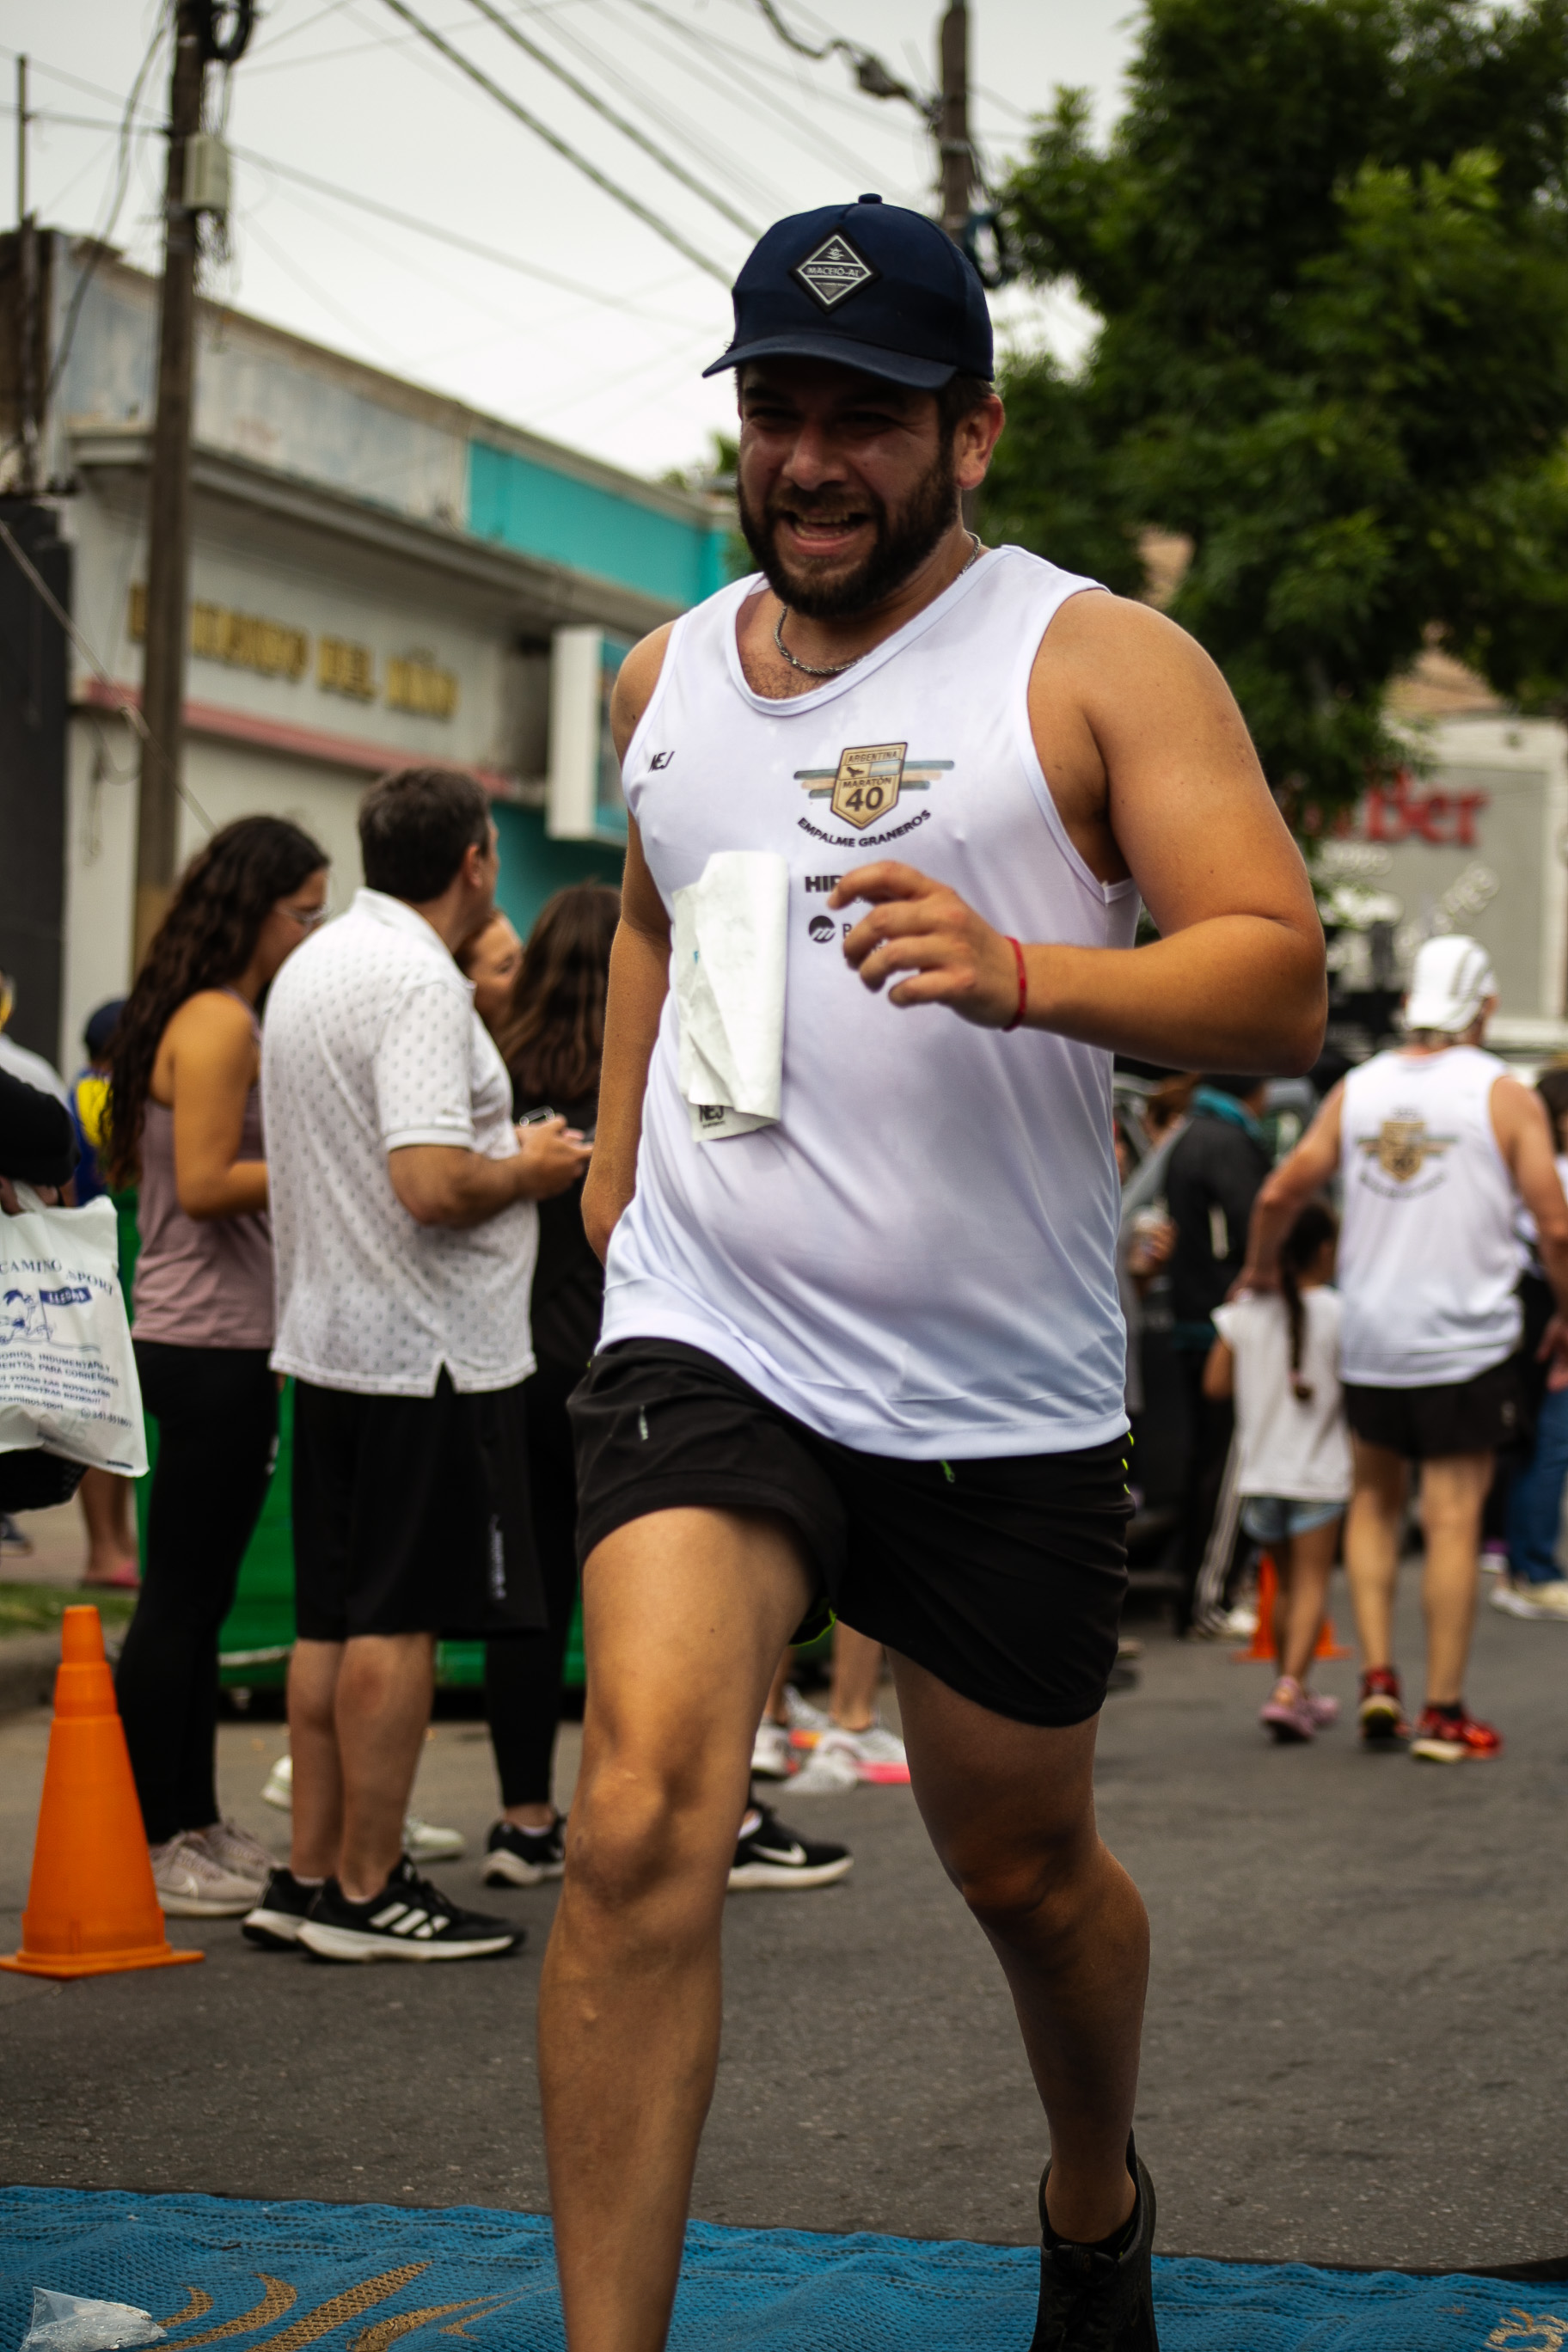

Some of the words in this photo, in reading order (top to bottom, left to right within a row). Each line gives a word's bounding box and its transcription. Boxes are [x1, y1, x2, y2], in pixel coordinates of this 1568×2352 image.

[848, 750, 898, 763] ARGENTINA
[842, 776, 892, 789] MARATÓN
[845, 787, 885, 812] 40
[797, 817, 855, 848] EMPALME
[858, 809, 932, 848] GRANEROS
[39, 1363, 62, 1374] PARA
